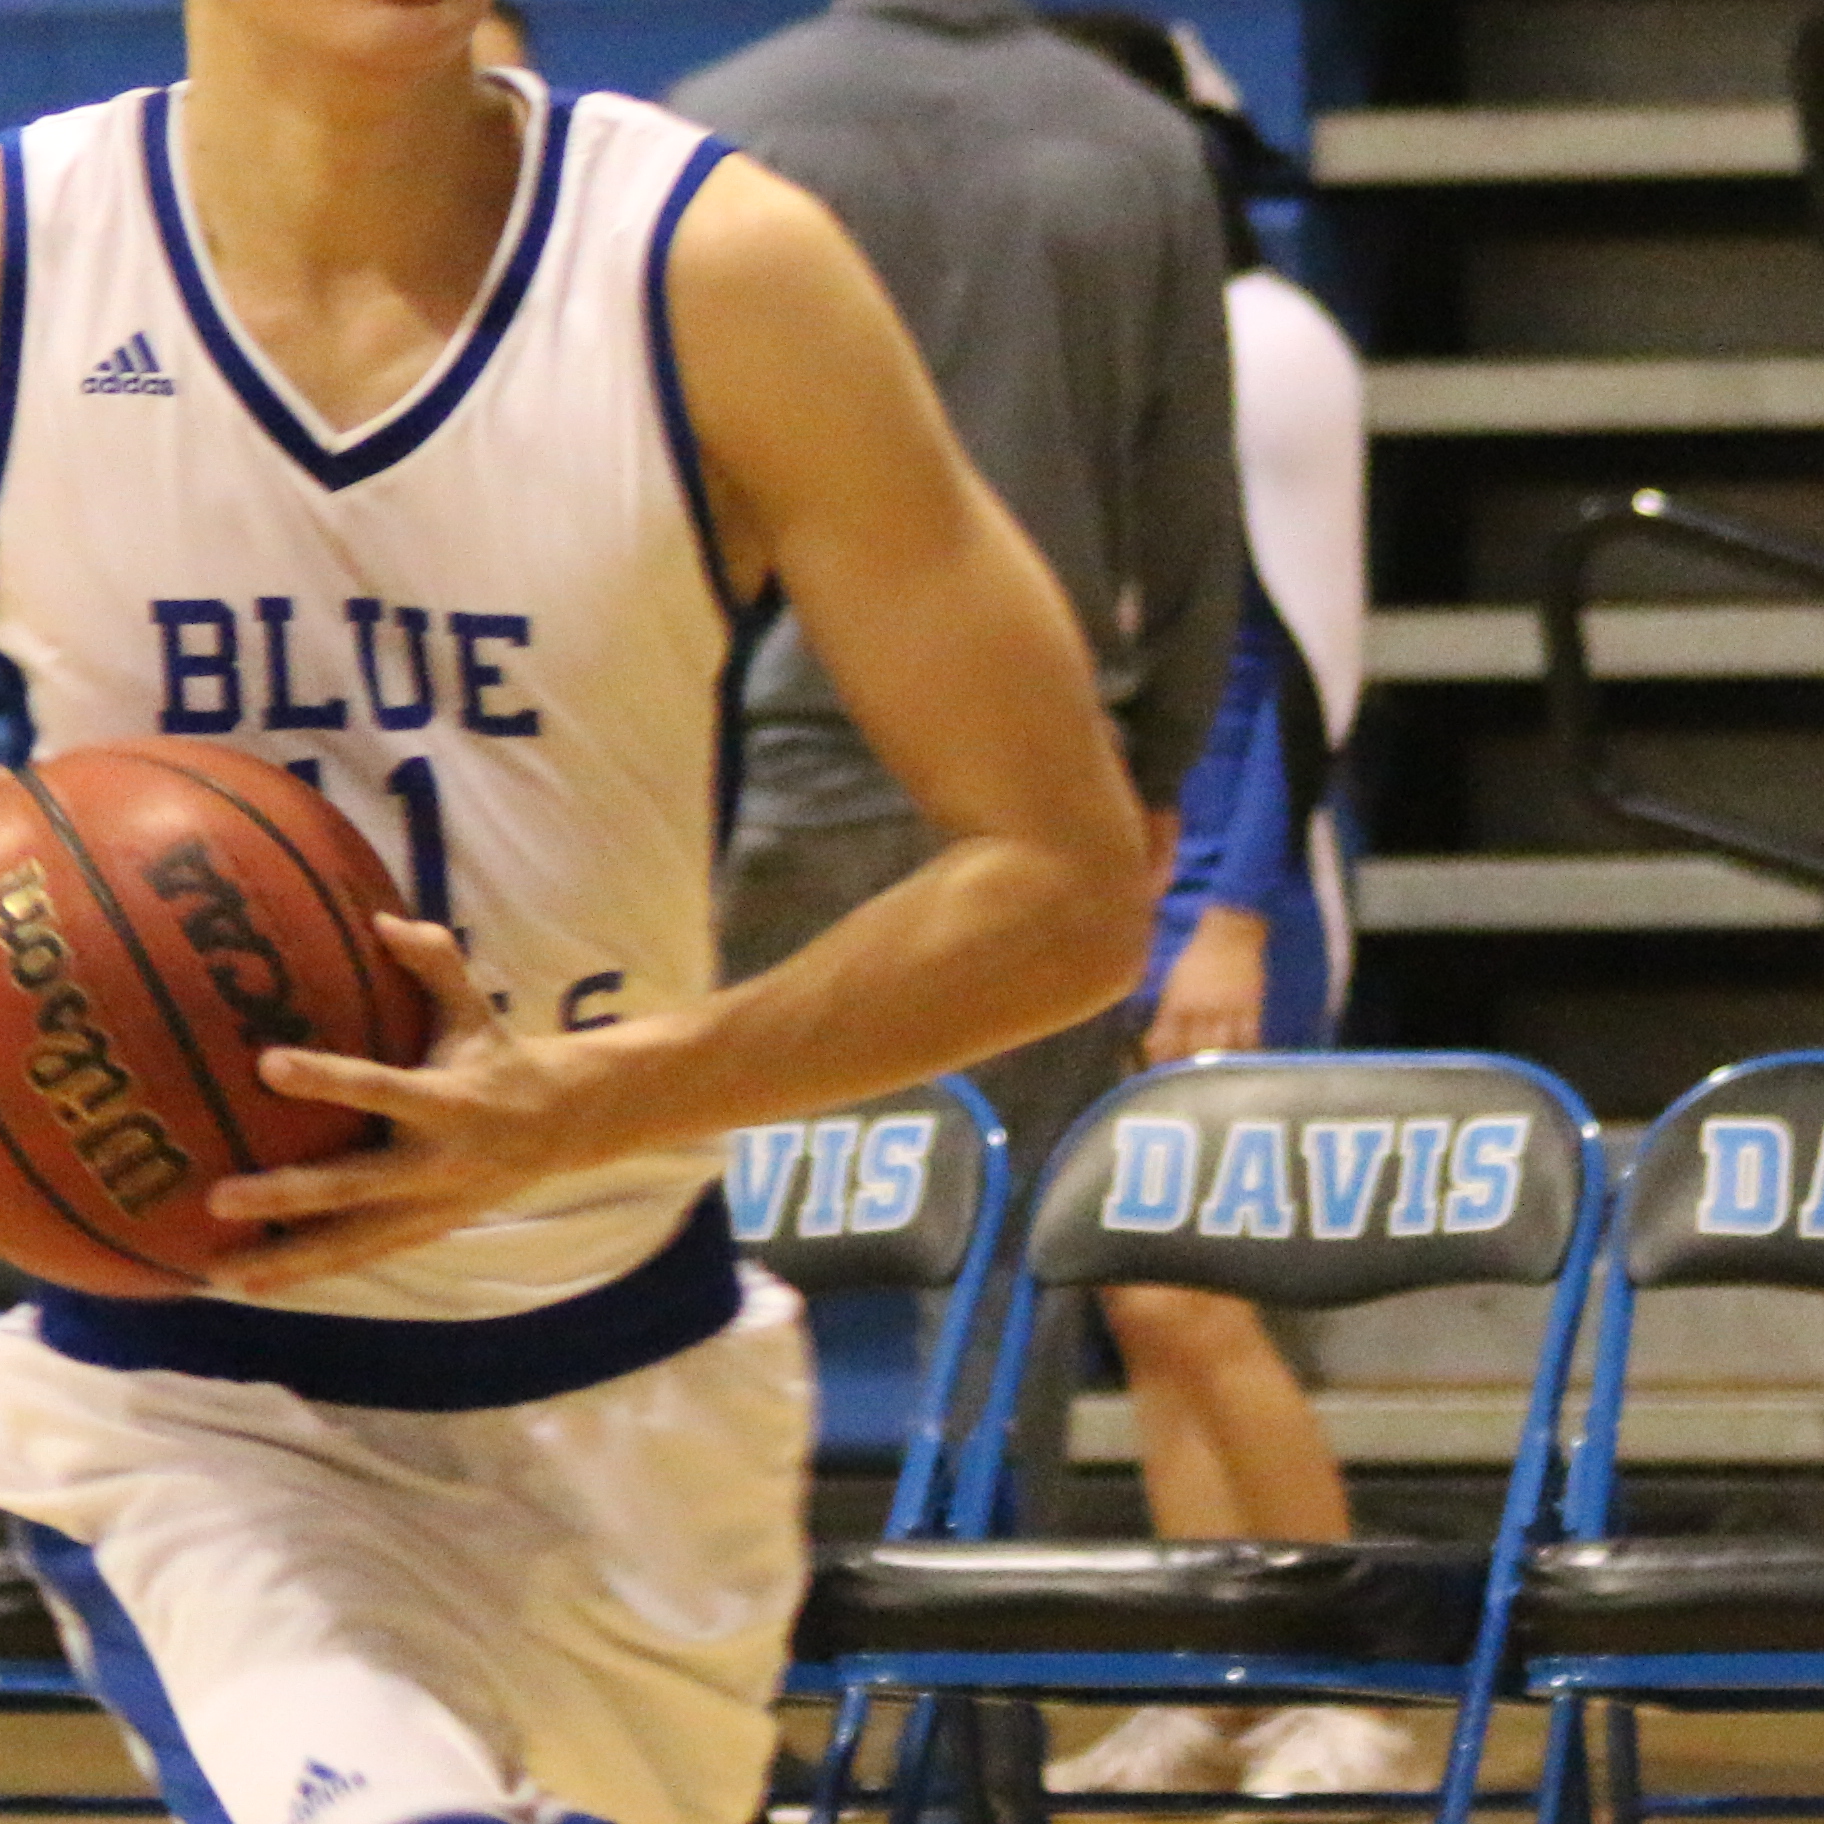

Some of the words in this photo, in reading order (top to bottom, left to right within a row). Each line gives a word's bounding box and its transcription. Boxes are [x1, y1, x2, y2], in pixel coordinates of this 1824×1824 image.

[79, 375, 174, 396] adidas
[149, 596, 541, 737] BLUE
[725, 1114, 937, 1242] VIS
[1101, 1114, 1531, 1240] DAVIS
